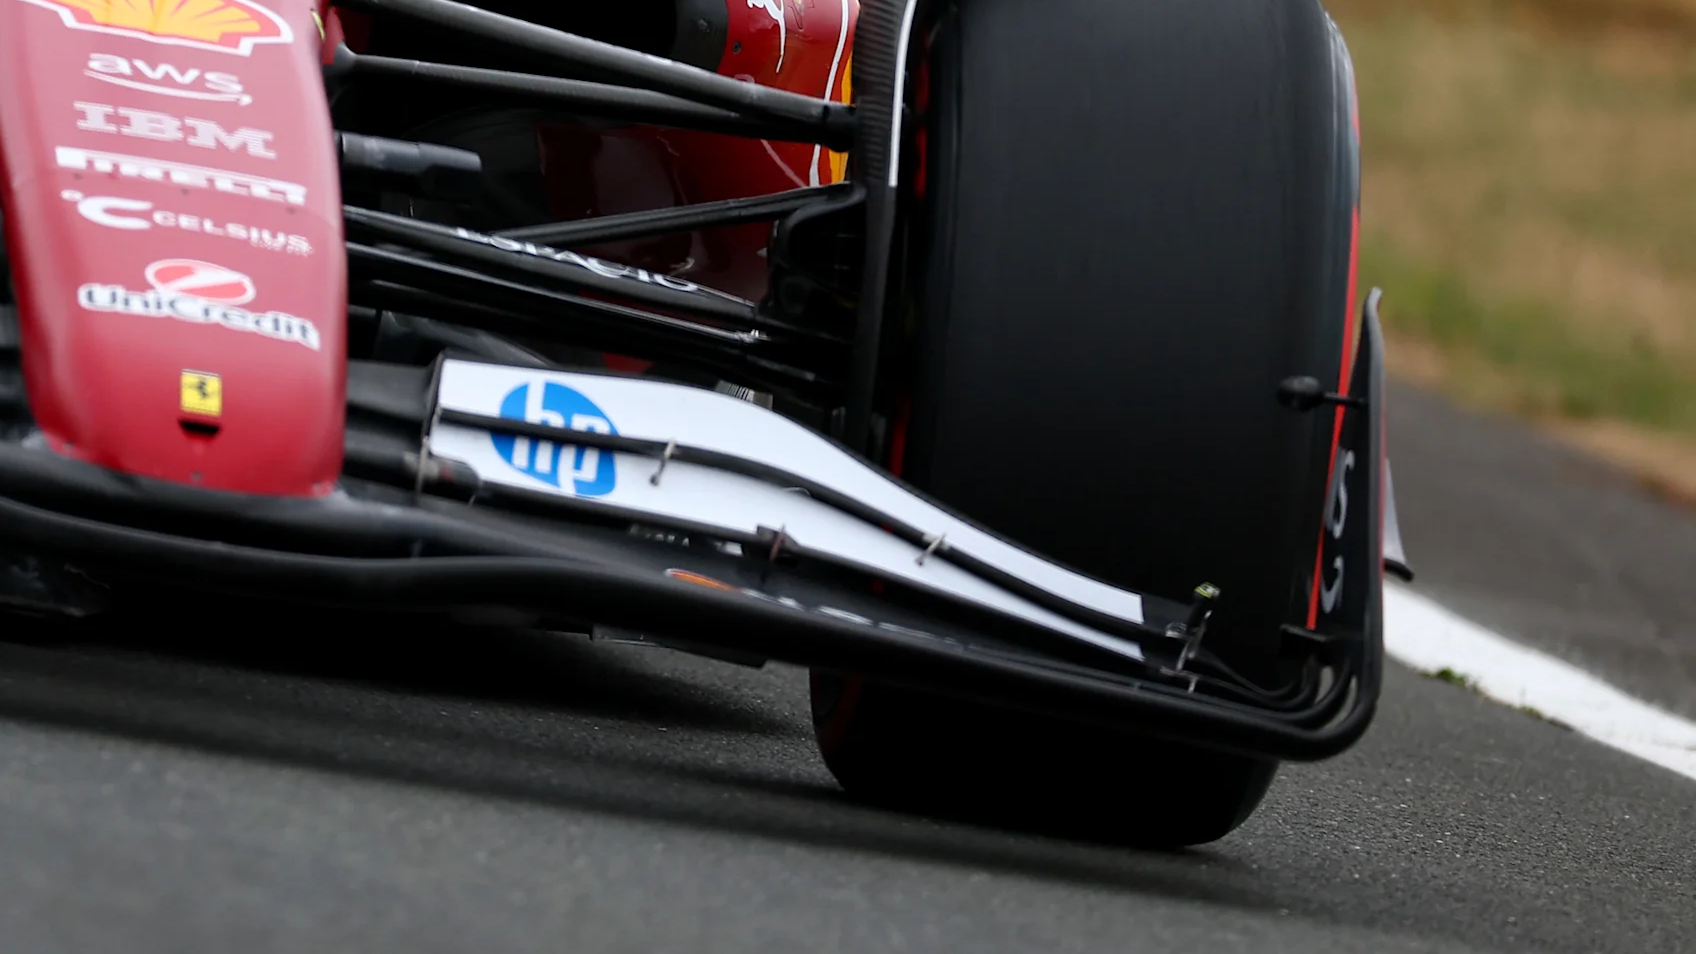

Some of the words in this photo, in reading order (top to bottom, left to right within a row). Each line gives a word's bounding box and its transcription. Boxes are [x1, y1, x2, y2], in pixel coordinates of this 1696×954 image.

[87, 52, 246, 96] aws
[73, 100, 277, 160] IBM
[54, 145, 307, 206] PIRELLI
[152, 210, 312, 254] CELSIUS
[78, 283, 320, 350] UniCredit
